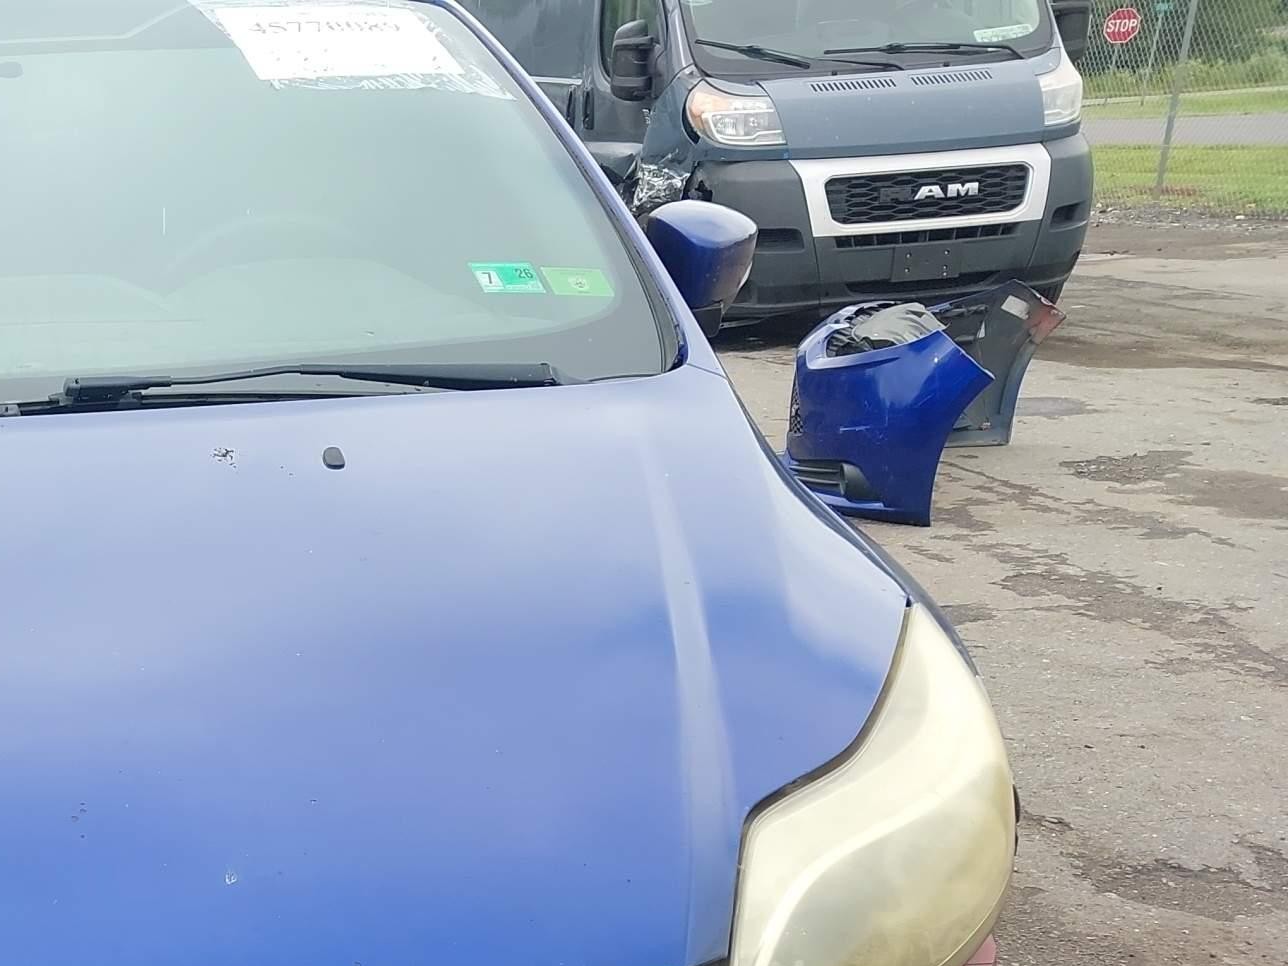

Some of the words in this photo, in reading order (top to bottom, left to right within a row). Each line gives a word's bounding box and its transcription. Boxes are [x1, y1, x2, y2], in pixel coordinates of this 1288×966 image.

[1106, 19, 1138, 33] STOP
[481, 271, 493, 285] 7
[514, 268, 534, 279] 26
